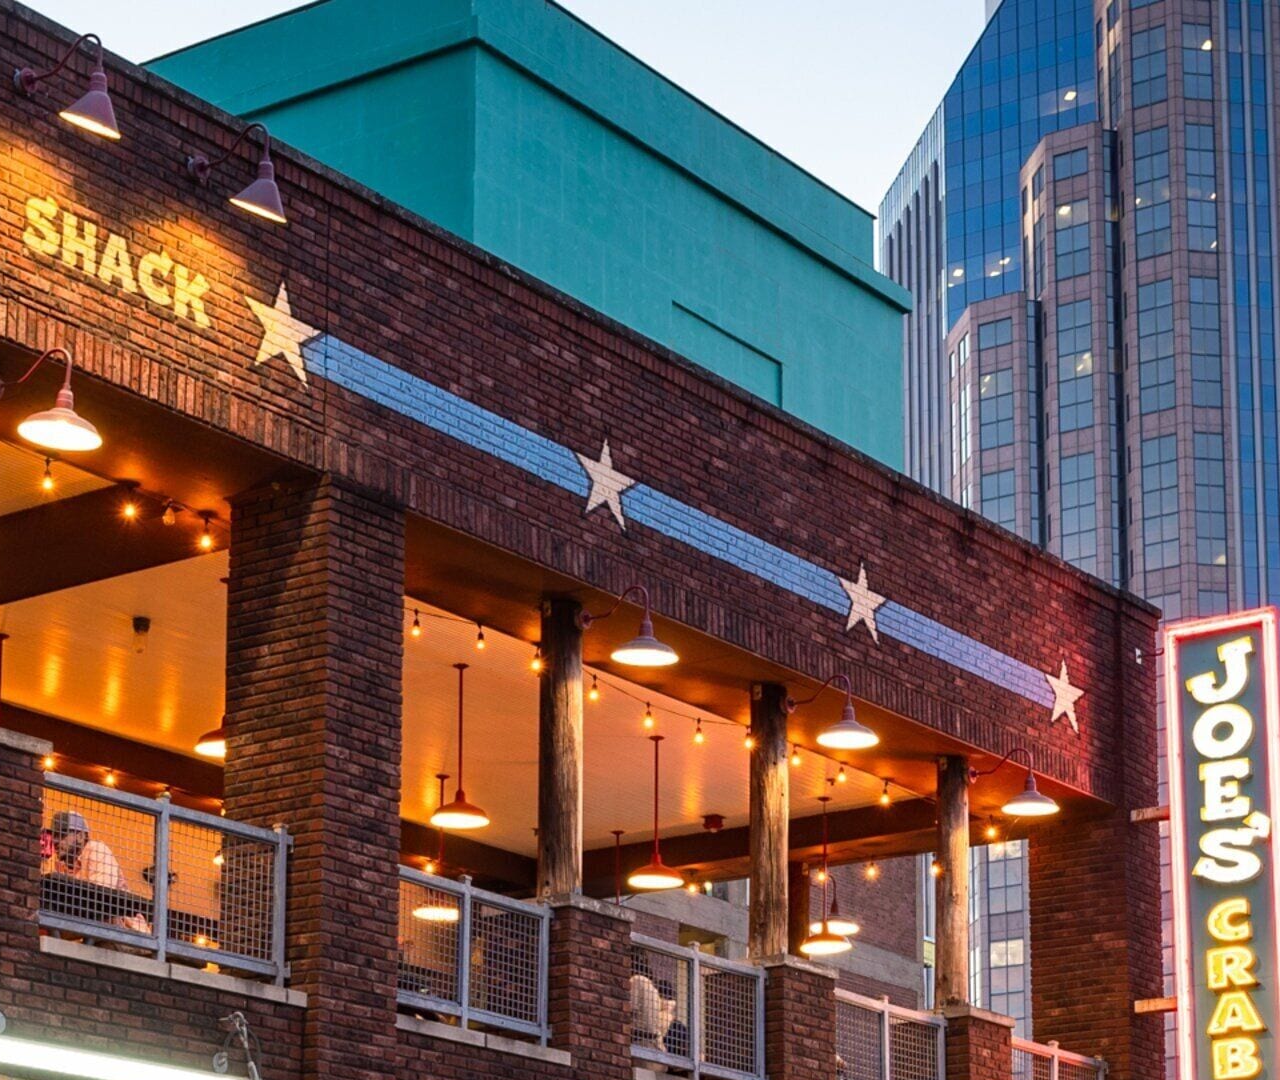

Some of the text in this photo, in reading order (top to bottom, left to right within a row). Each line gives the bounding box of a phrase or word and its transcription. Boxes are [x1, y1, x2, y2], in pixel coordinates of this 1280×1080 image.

[23, 196, 212, 329] SHACK
[1185, 636, 1271, 883] JOE'S
[1206, 898, 1267, 1080] CRAB
